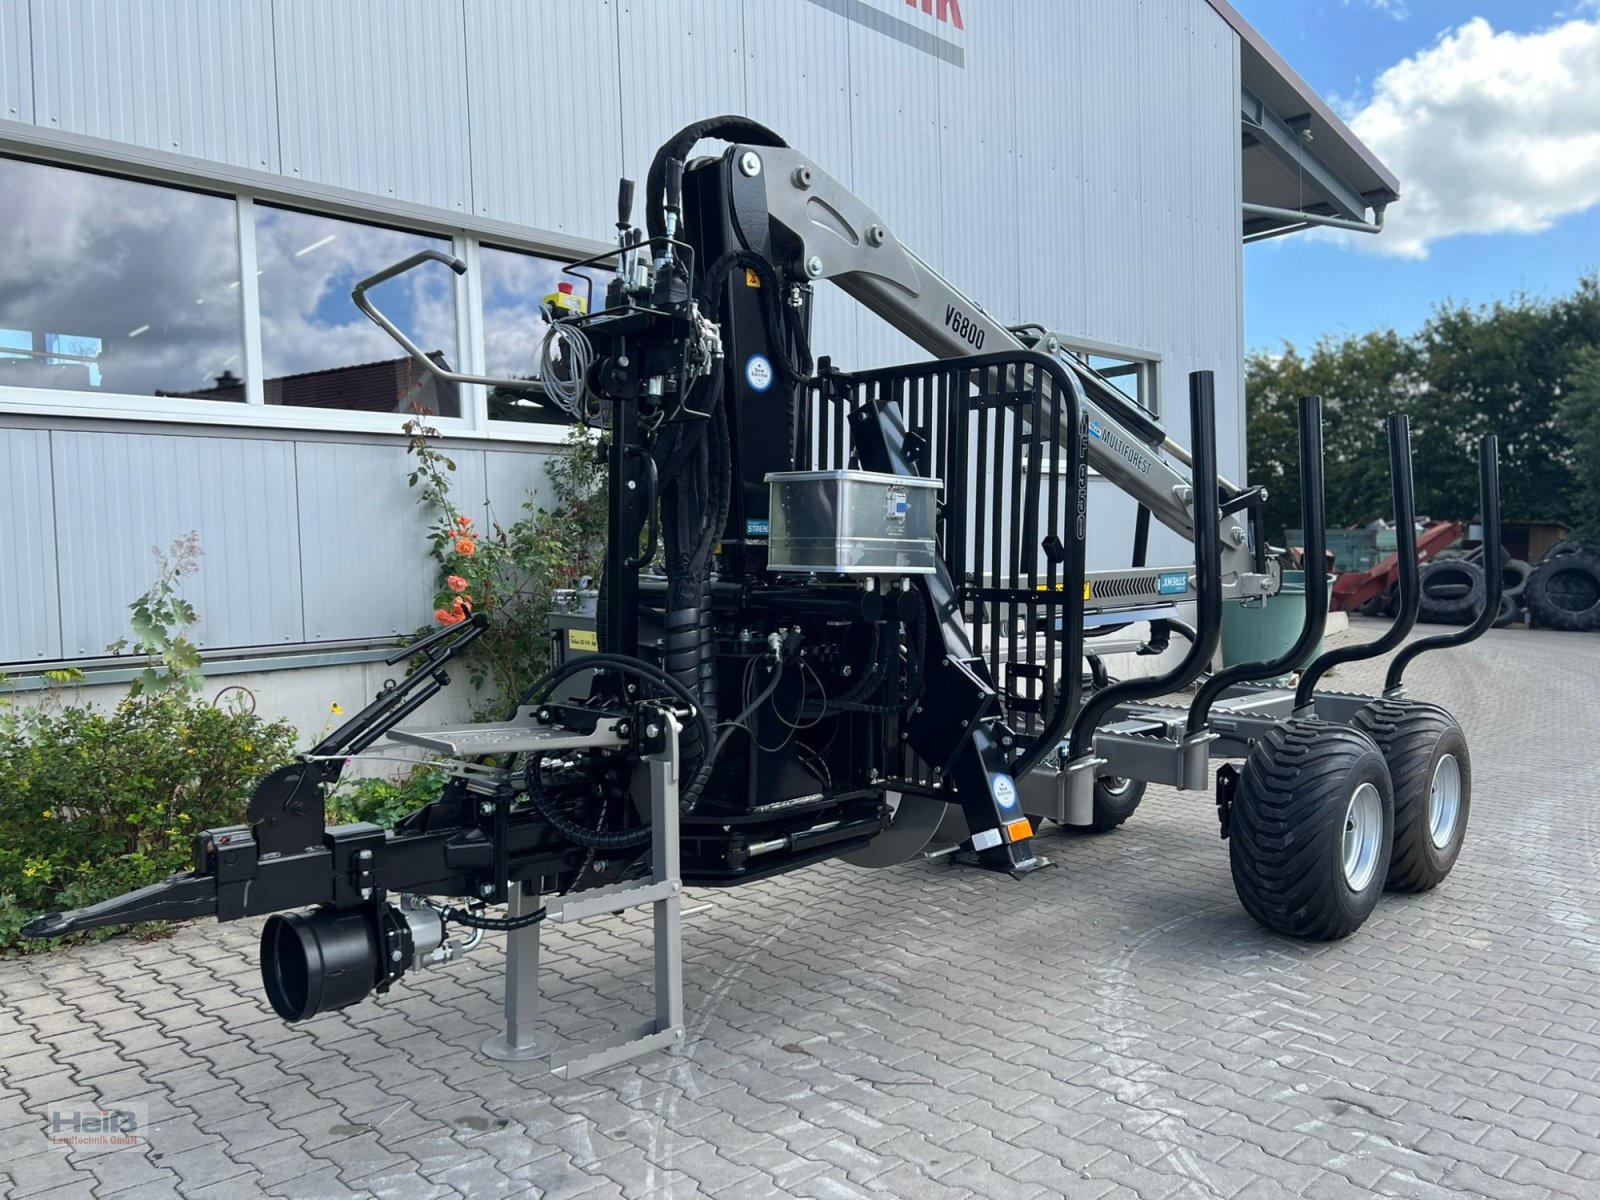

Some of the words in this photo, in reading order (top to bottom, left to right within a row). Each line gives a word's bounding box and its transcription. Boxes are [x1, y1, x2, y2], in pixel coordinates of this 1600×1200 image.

[945, 304, 985, 350] V6800
[1079, 412, 1089, 458] MF
[1102, 428, 1151, 475] MULTIFOREST
